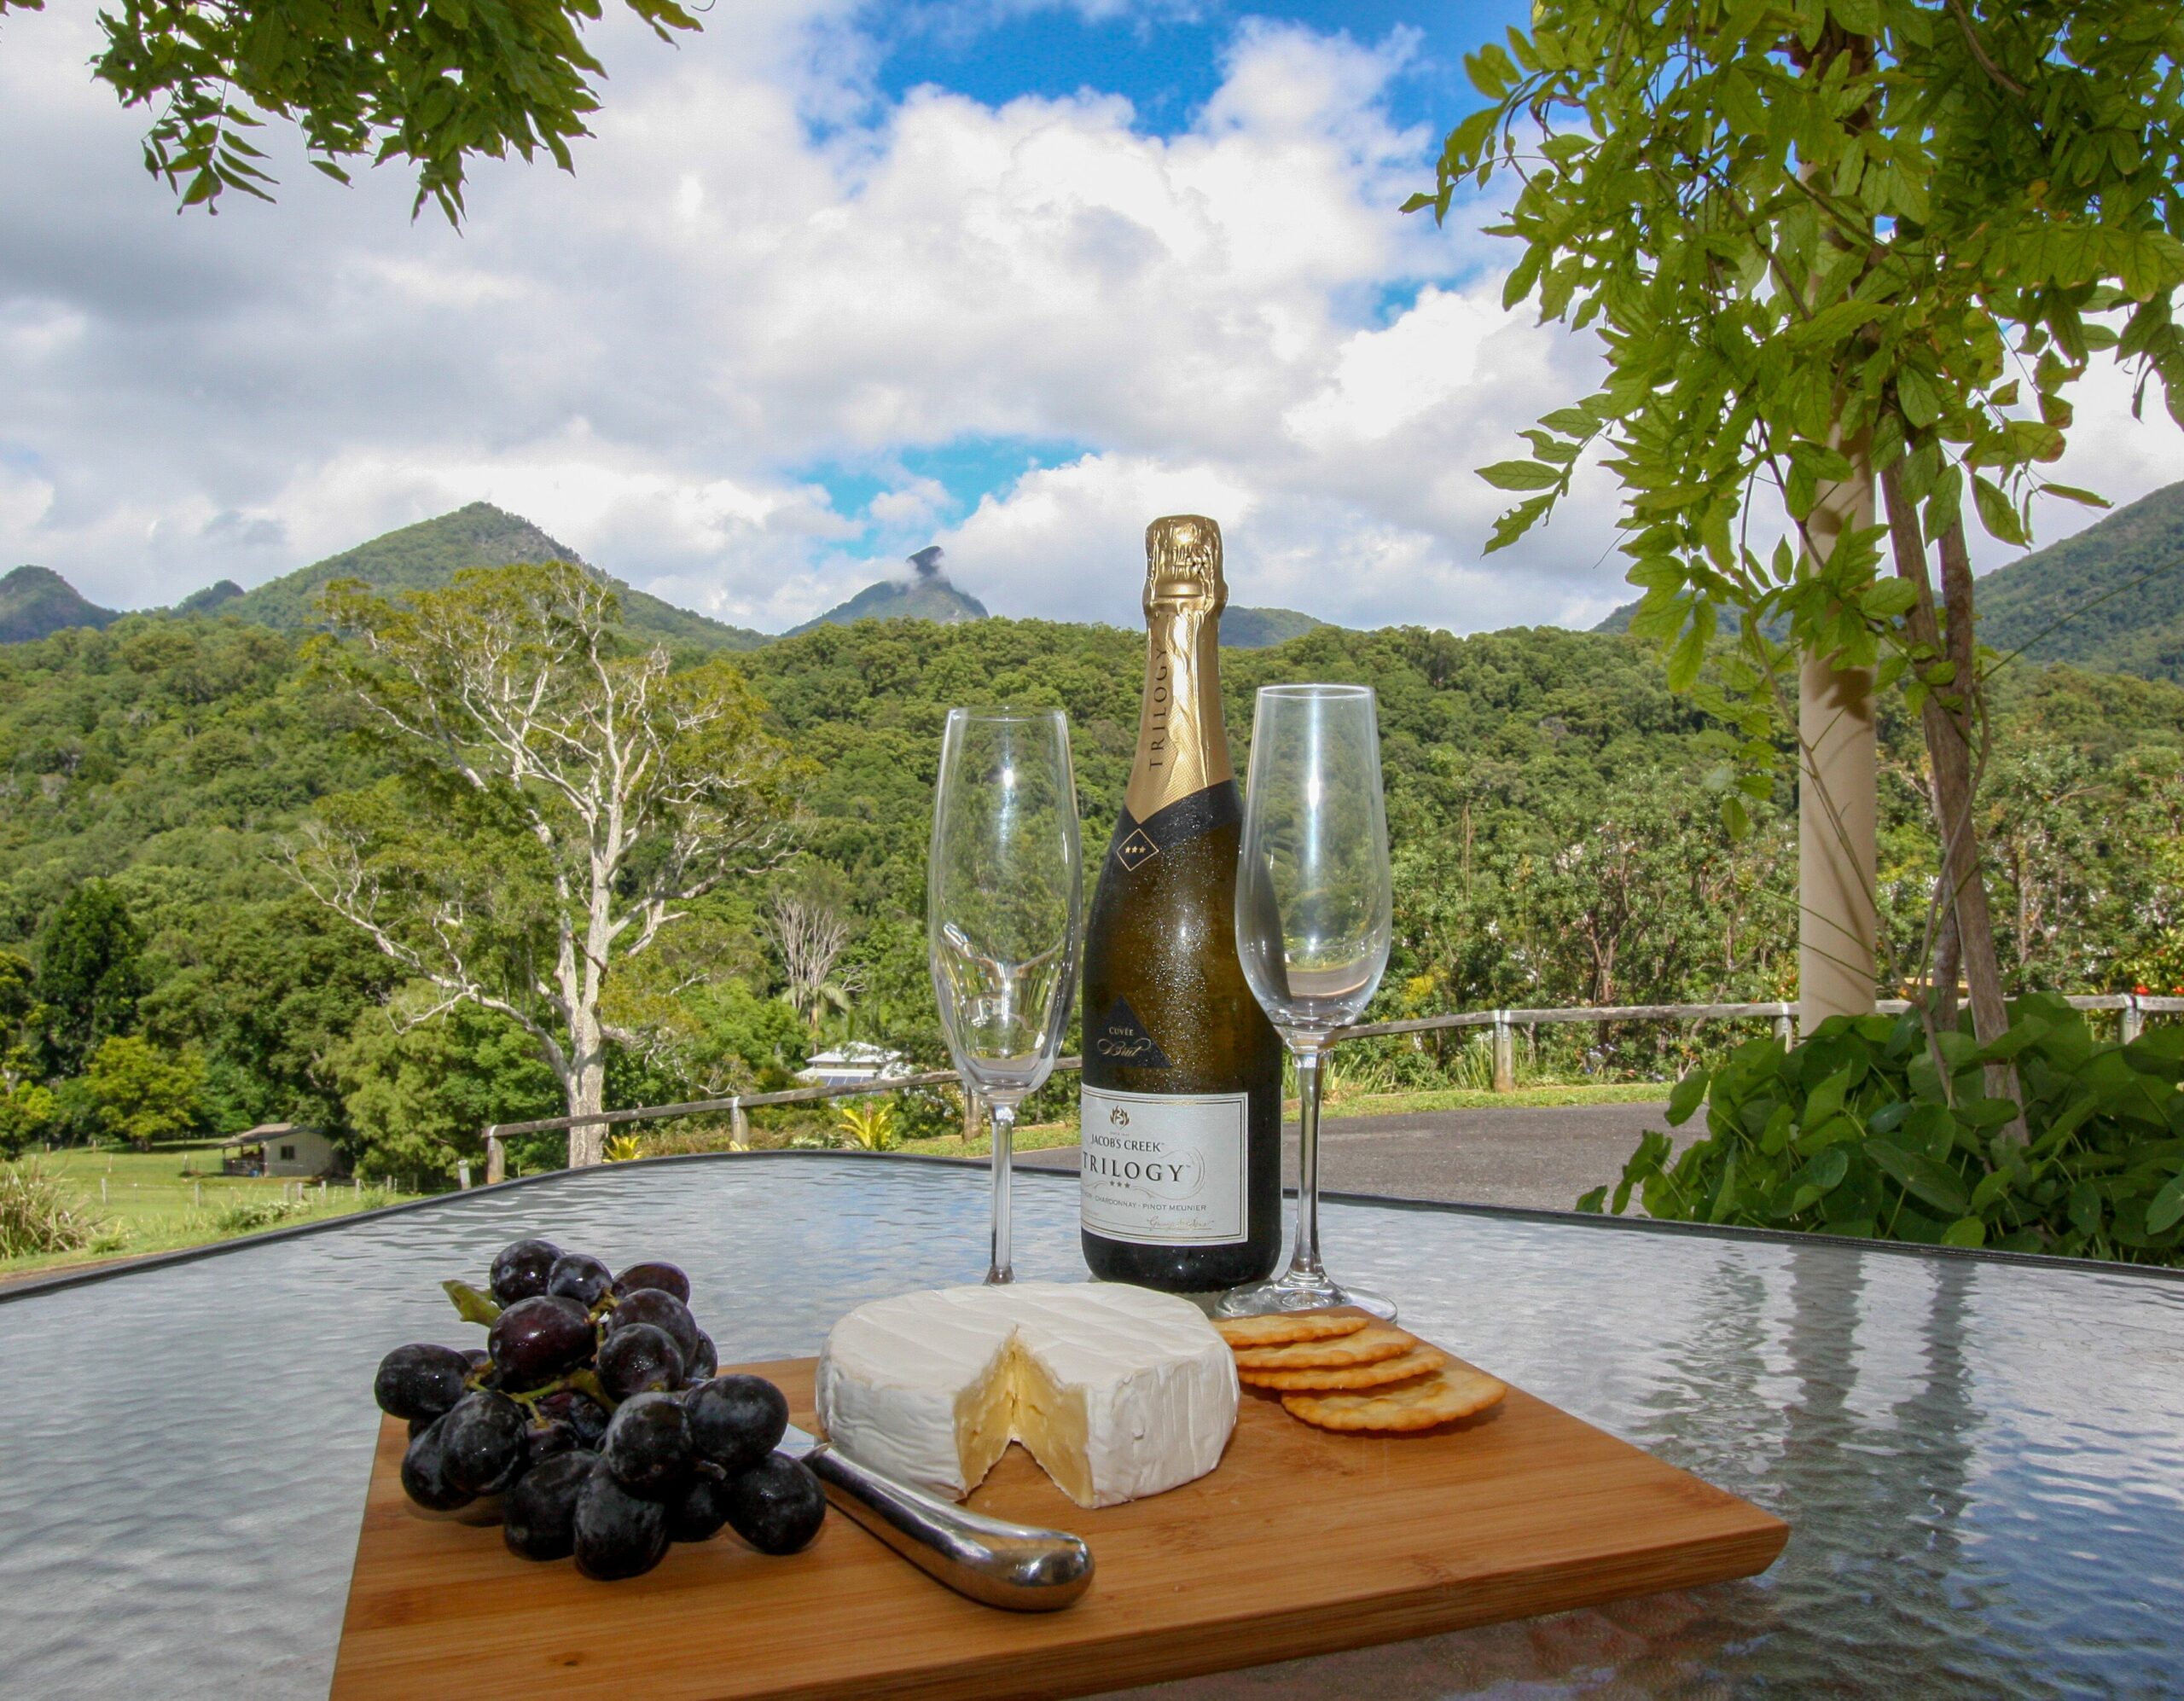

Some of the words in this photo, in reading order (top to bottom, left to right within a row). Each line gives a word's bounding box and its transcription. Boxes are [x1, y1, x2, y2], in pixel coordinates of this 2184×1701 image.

[1148, 647, 1168, 771] TRILOGY
[1090, 1133, 1122, 1149] JACOB'S
[1124, 1140, 1161, 1152] CREEK
[1083, 1151, 1184, 1182] TRILOGY
[1095, 1195, 1137, 1209] CHARDONNAY
[1142, 1203, 1166, 1211] PINOT
[1169, 1204, 1207, 1212] MEUNIER
